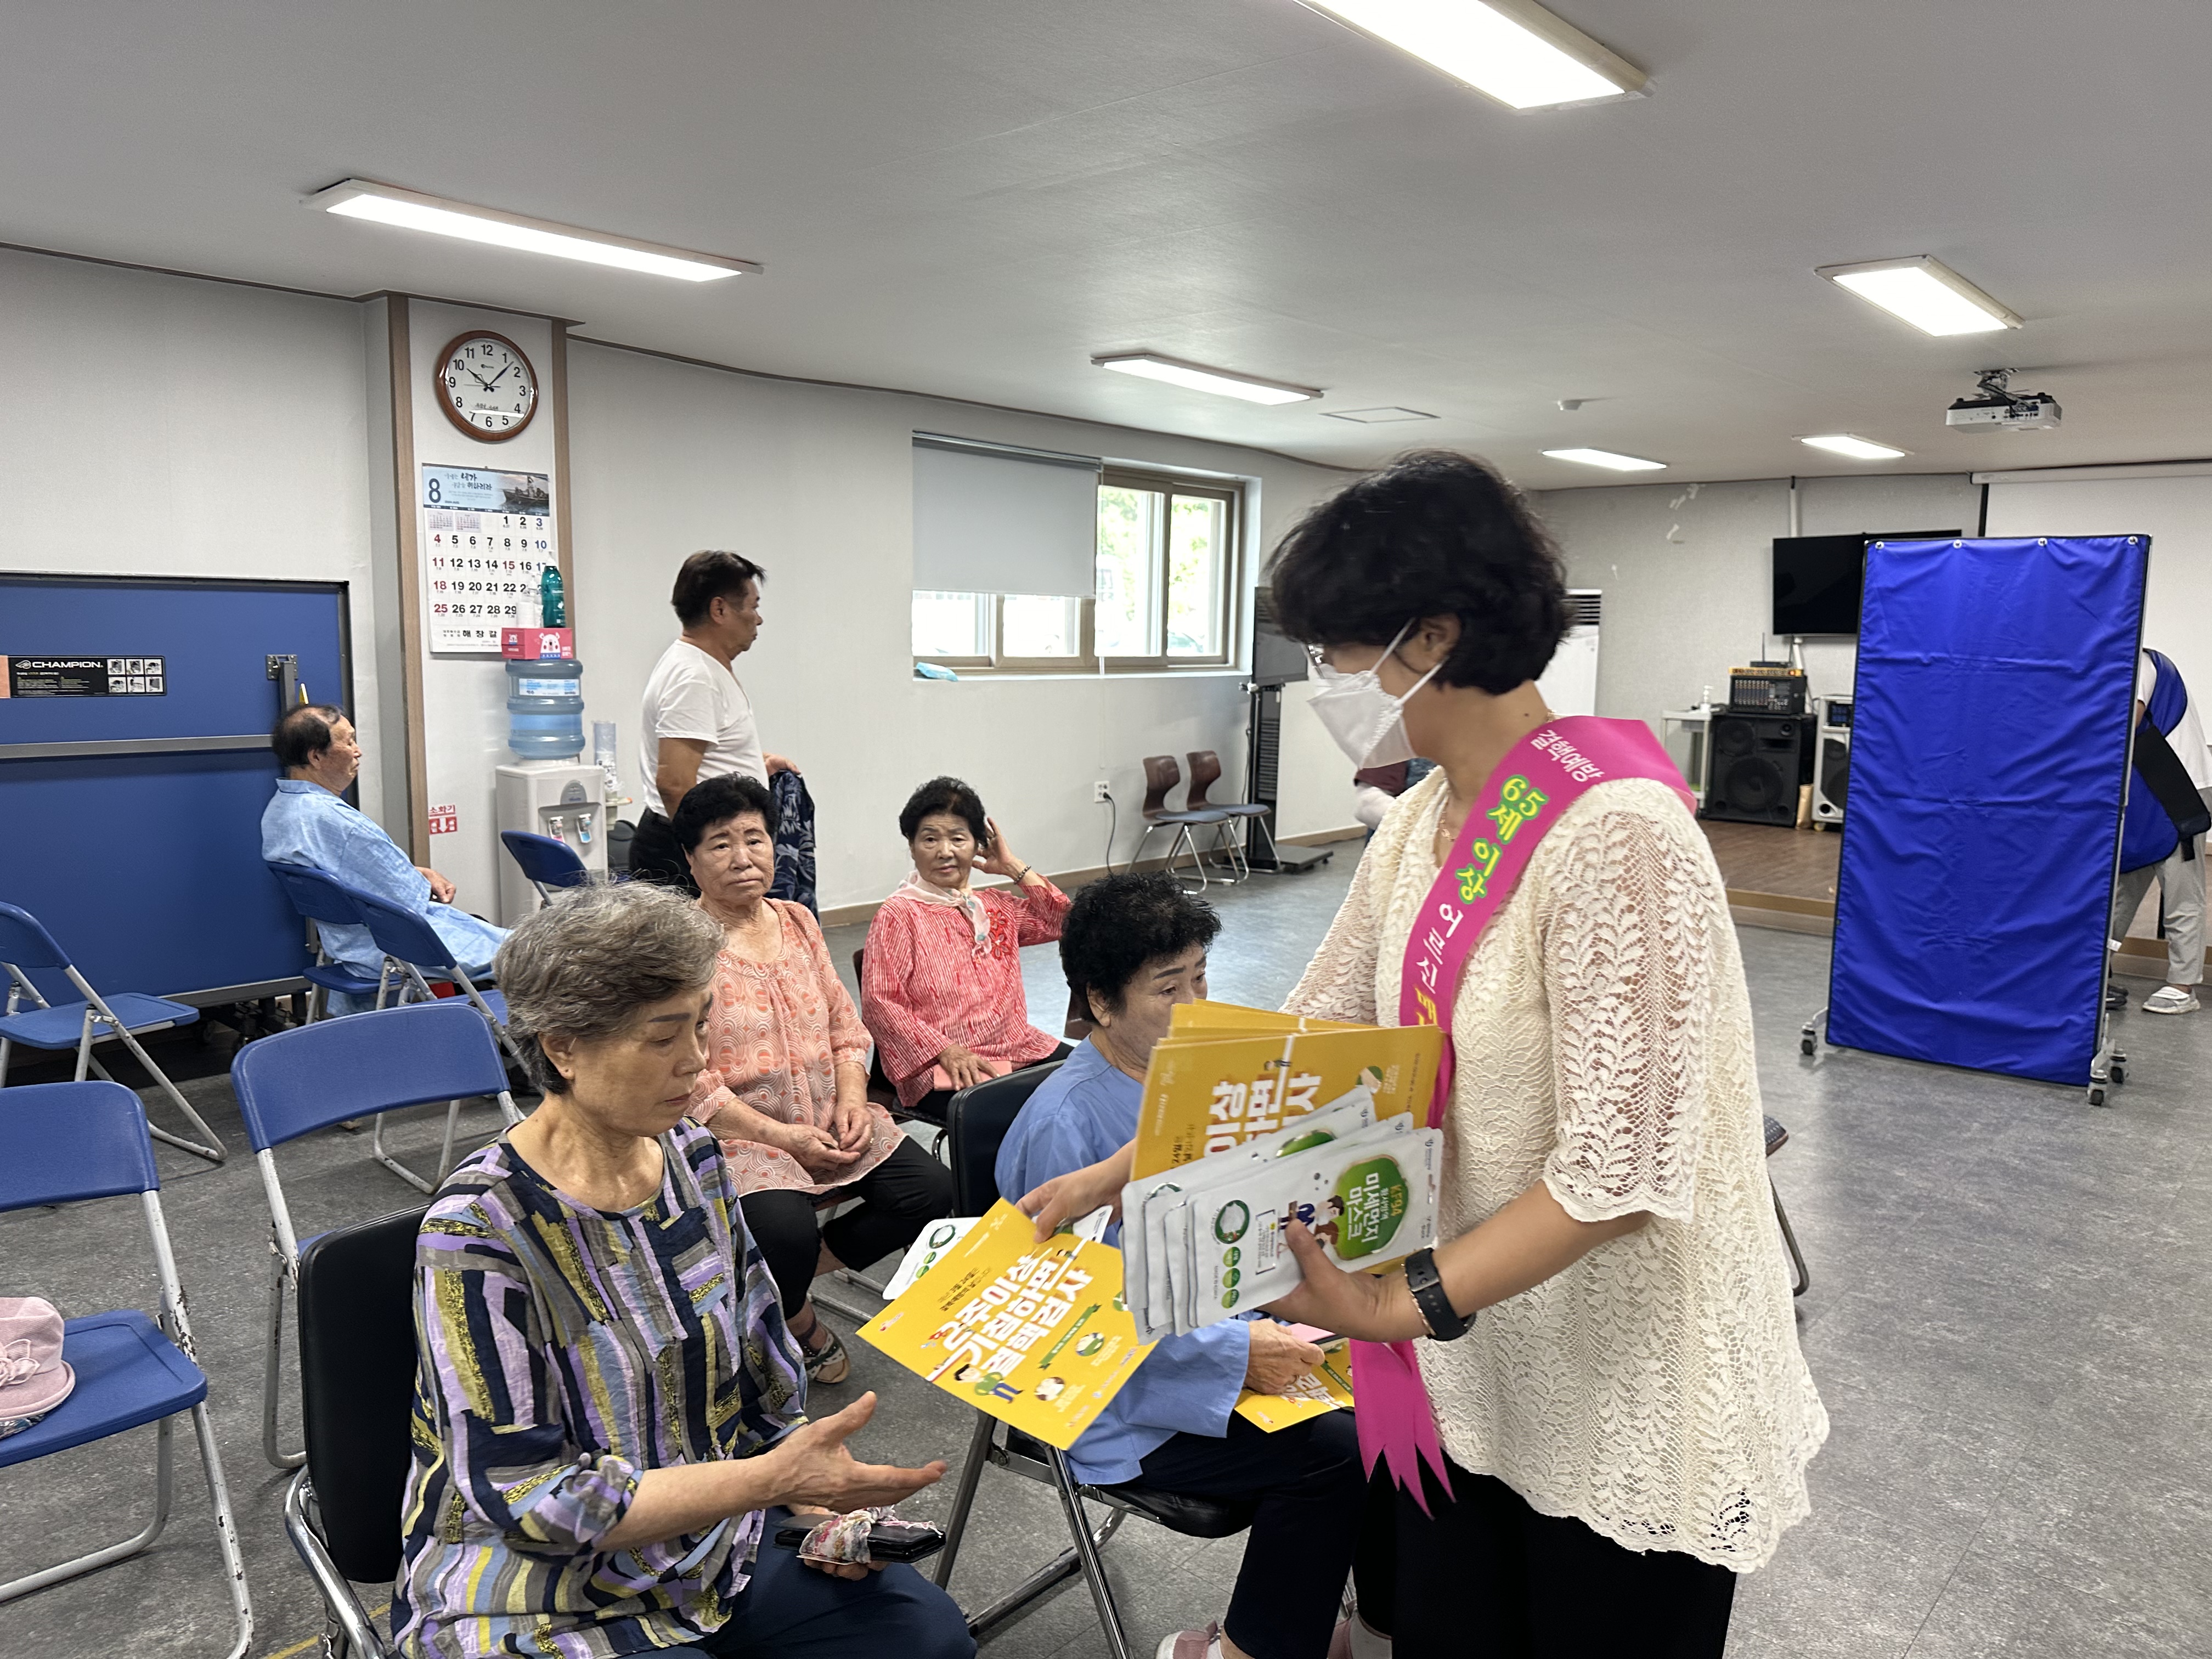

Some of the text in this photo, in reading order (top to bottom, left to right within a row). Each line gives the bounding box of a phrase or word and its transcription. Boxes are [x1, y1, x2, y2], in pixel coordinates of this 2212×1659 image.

[464, 347, 475, 359] 11
[481, 344, 493, 356] 12
[502, 352, 507, 363] 1
[453, 359, 464, 371] 10
[514, 366, 521, 378] 2
[449, 376, 456, 388] 9
[519, 385, 526, 396] 3
[456, 397, 463, 408] 8
[514, 403, 521, 414] 4
[471, 413, 476, 422] 7
[486, 416, 493, 427] 6
[502, 415, 509, 426] 5
[428, 478, 441, 503] 8
[503, 515, 543, 527] 1 2 3
[434, 534, 547, 549] 4 5 6 7 8 9 10
[432, 557, 444, 567] 11
[450, 558, 464, 568] 12
[467, 558, 481, 568] 13
[486, 560, 498, 569] 14
[503, 561, 515, 570] 15
[520, 561, 532, 571] 16
[433, 580, 447, 590] 18
[452, 581, 465, 590] 19
[469, 582, 482, 591] 20
[486, 582, 498, 592] 21
[503, 583, 517, 592] 22
[520, 584, 528, 593] 2
[434, 603, 517, 614] 25 26 27 28 29
[1530, 729, 1604, 782] 결핵예방
[429, 804, 455, 813] 소화기
[1487, 775, 1549, 844] 65세
[1456, 838, 1502, 904] 이상
[1416, 903, 1464, 994] 어르신
[1390, 1184, 1402, 1218] KF94
[1347, 1186, 1362, 1241] 마스크
[1363, 1172, 1379, 1243] 미세먼지
[957, 1259, 1062, 1367] 기침하면
[980, 1267, 1094, 1379] 결핵검사
